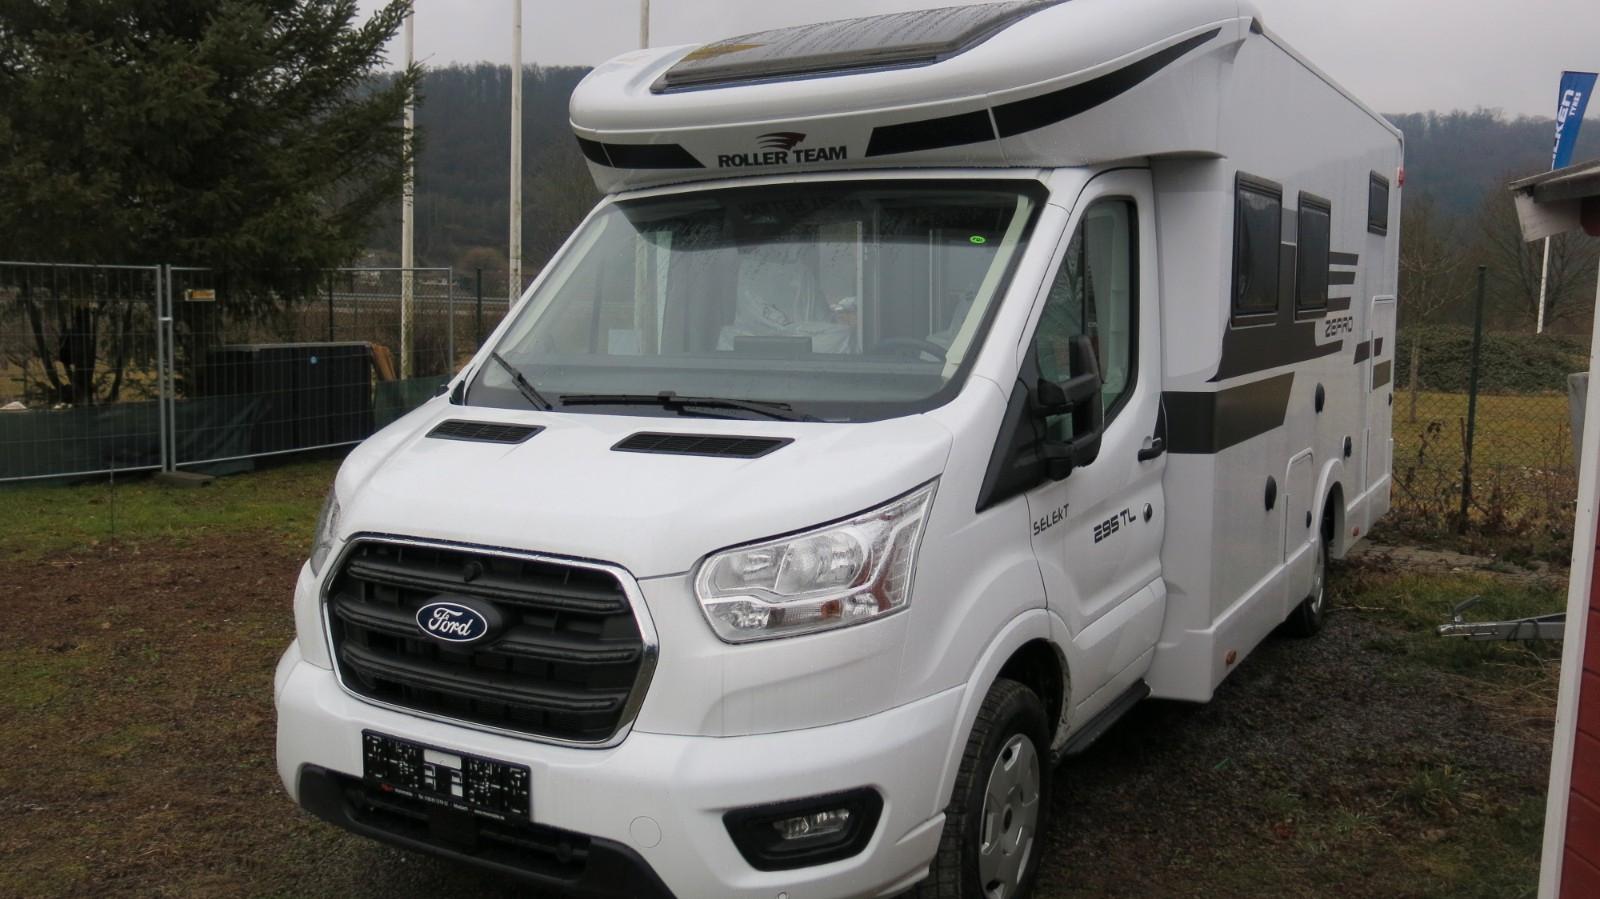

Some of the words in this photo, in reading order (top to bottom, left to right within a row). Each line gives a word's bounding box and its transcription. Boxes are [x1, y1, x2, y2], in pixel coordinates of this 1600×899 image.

[1568, 91, 1582, 117] TYRES
[718, 149, 788, 168] ROLLER
[793, 145, 847, 163] TEAM
[1033, 503, 1070, 536] SELEKT
[428, 607, 474, 636] Ford
